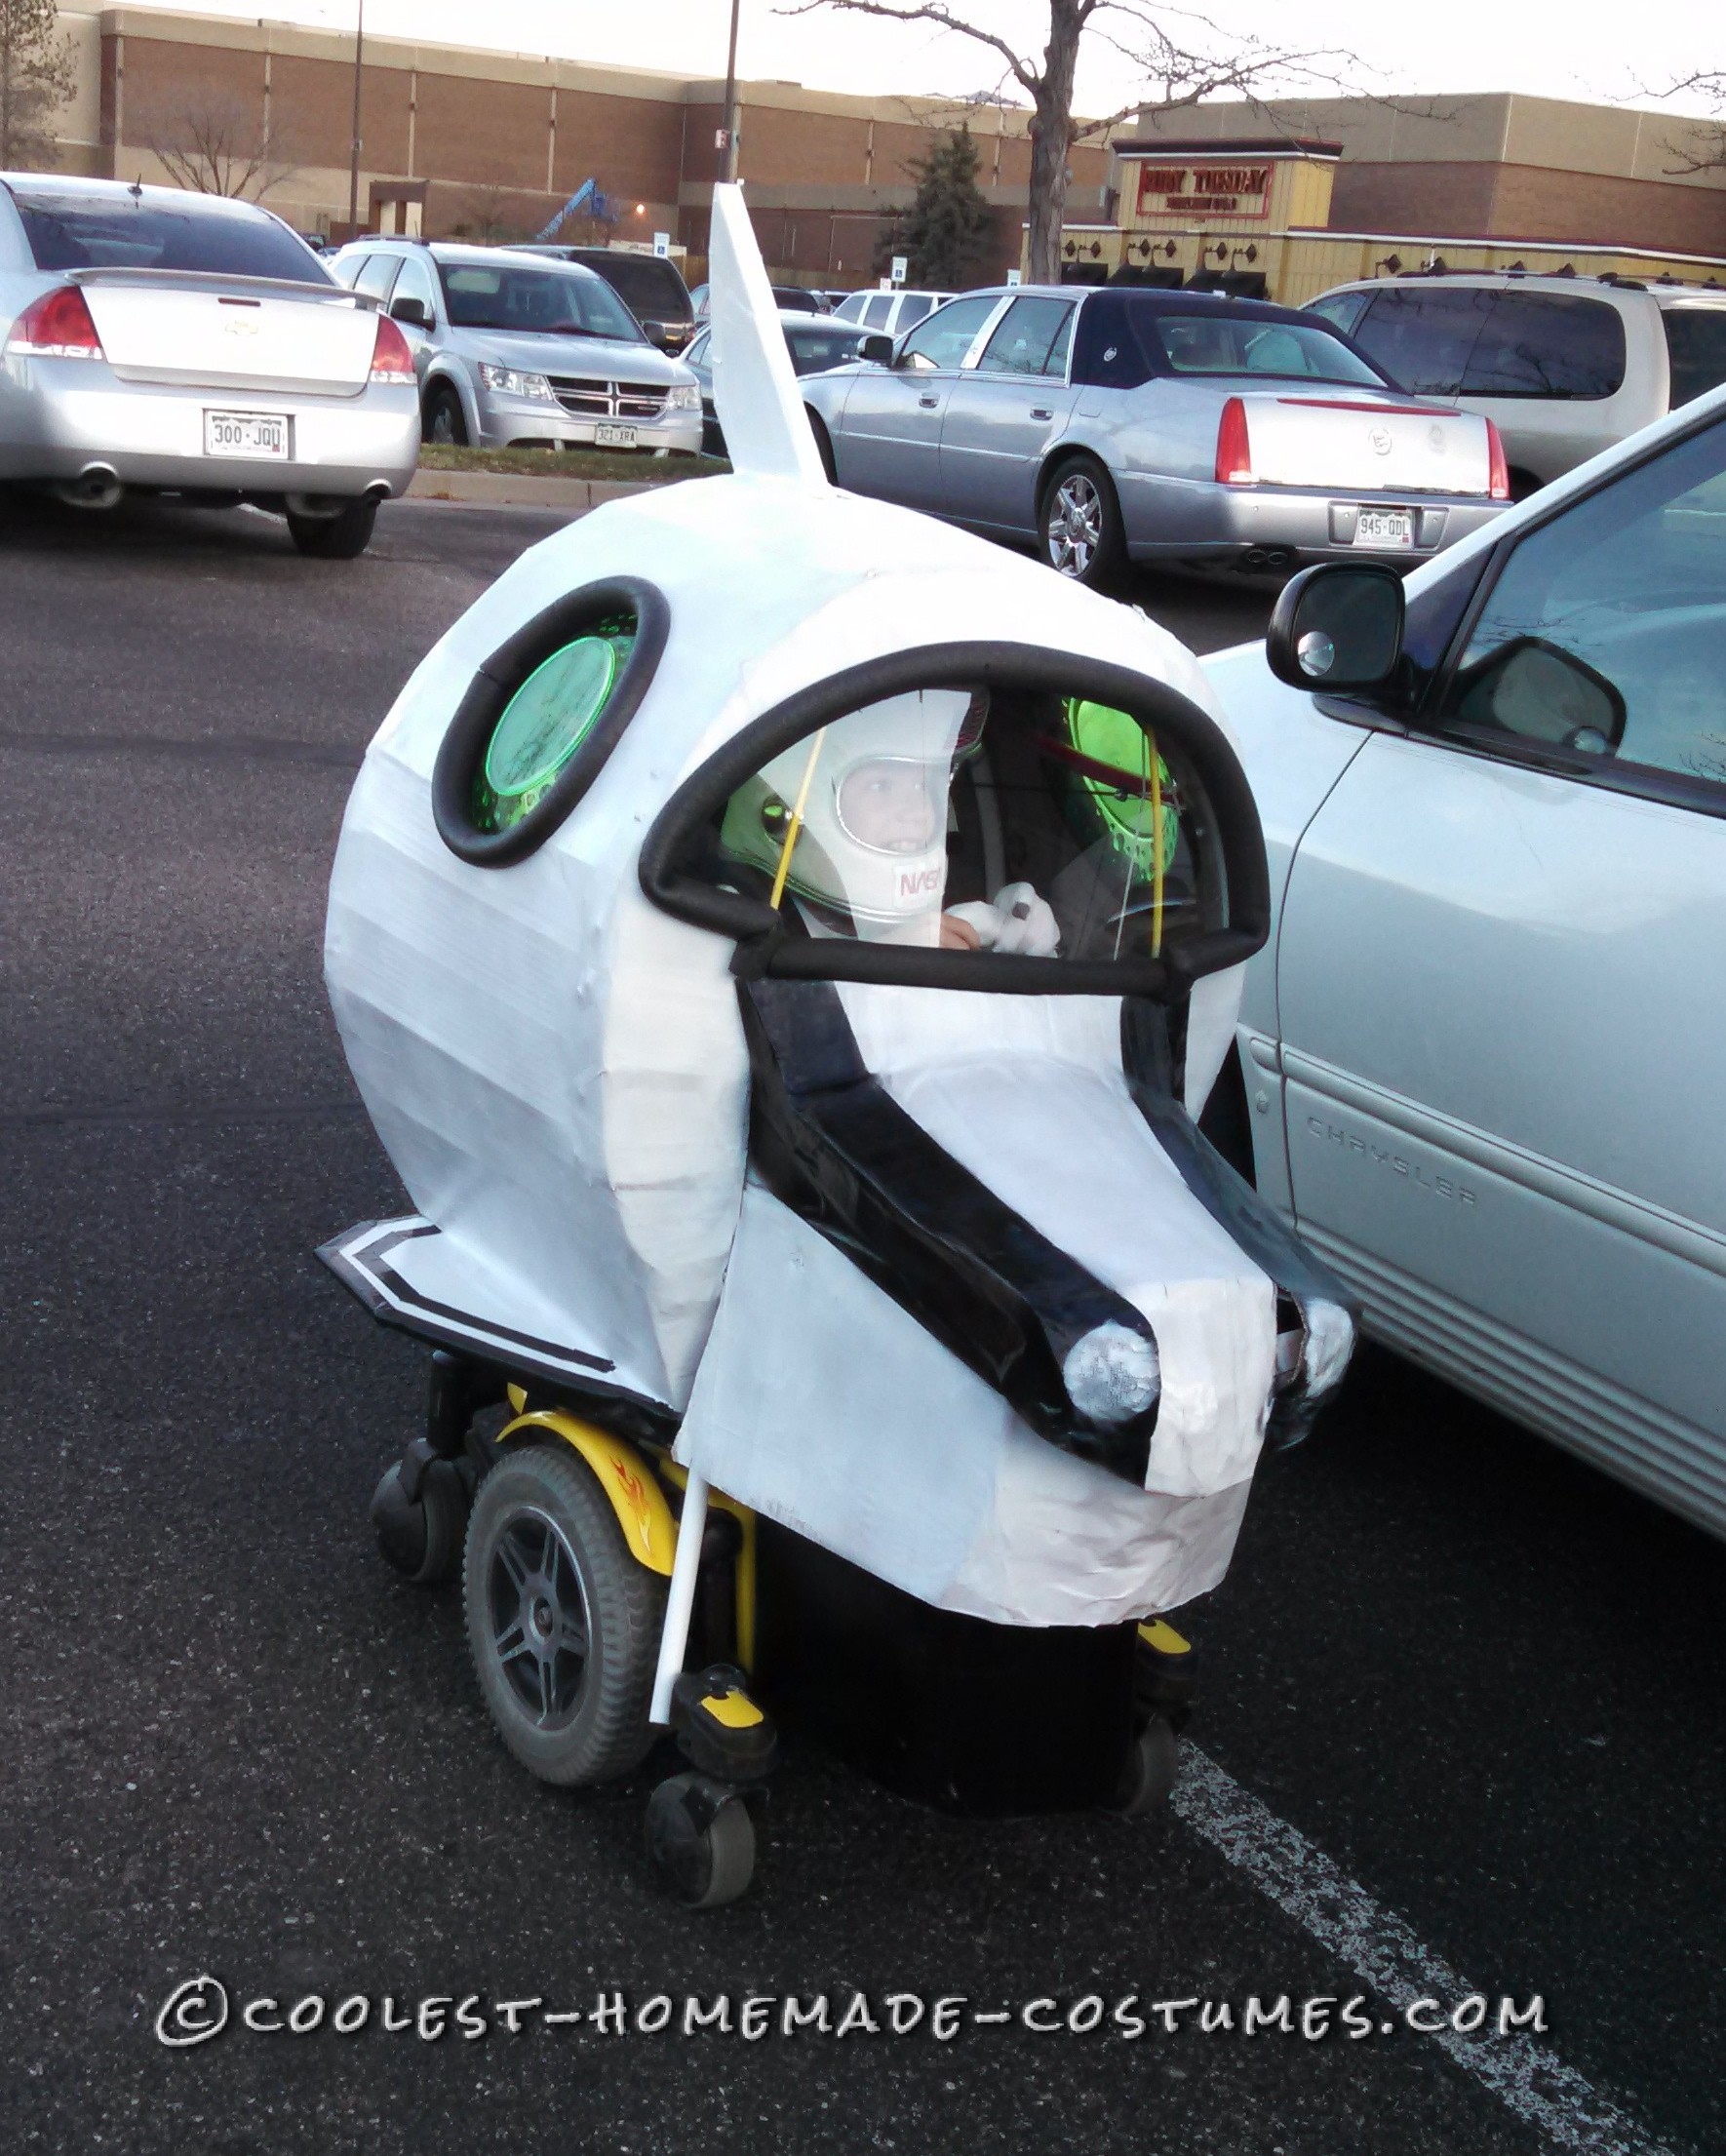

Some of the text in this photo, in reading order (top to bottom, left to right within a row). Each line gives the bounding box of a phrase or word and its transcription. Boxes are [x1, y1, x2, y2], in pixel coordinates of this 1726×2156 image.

[1193, 169, 1267, 194] TUESDAY
[900, 867, 941, 896] NAS
[1307, 1117, 1475, 1205] CHRYSLER
